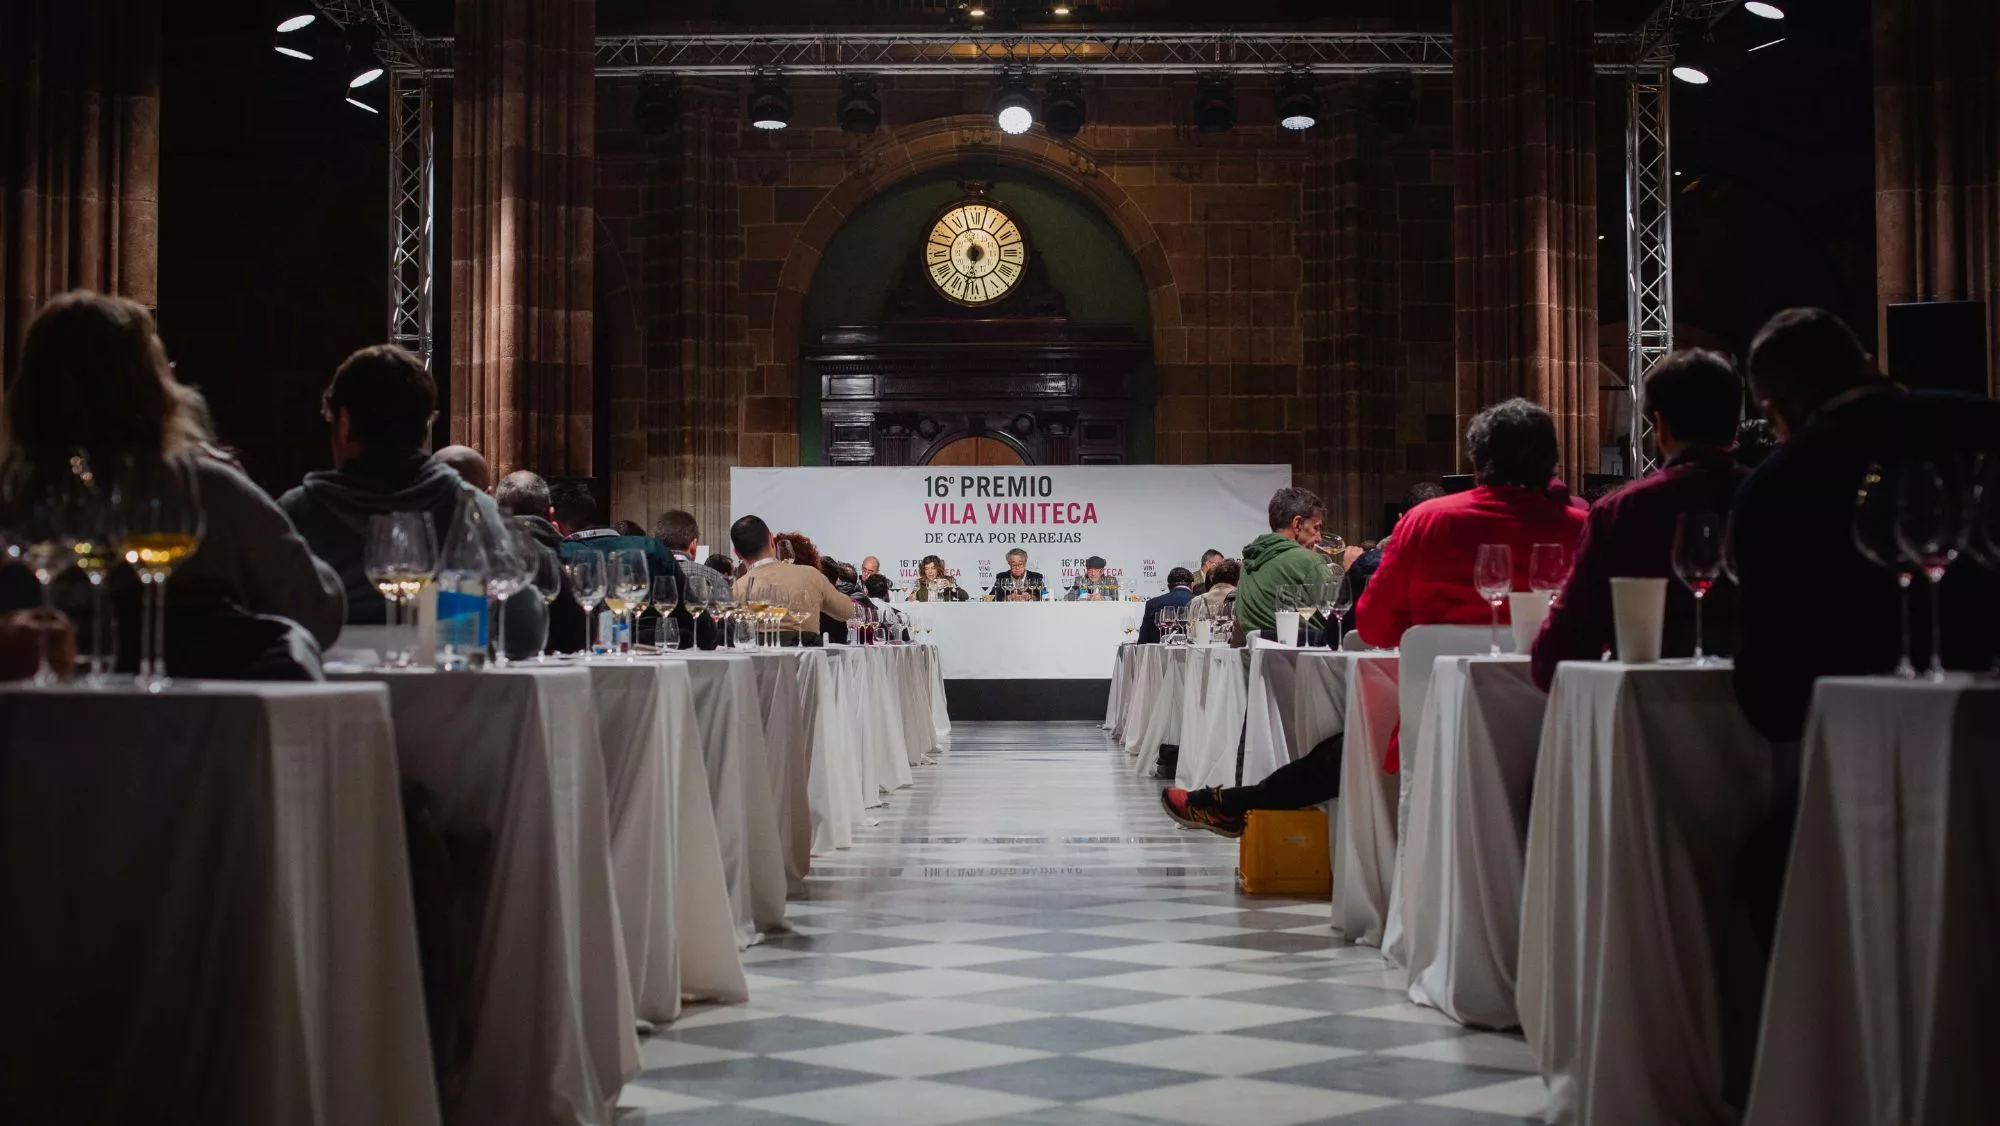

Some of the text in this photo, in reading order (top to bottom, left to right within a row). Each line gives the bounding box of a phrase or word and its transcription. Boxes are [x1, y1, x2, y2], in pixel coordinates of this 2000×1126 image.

[924, 476, 1052, 497] 16º PREMIO
[924, 503, 1098, 525] VILA VINITECA
[924, 532, 1082, 544] DE CATA POR PAREJAS
[899, 569, 918, 577] VILA
[1061, 569, 1080, 577] VILA
